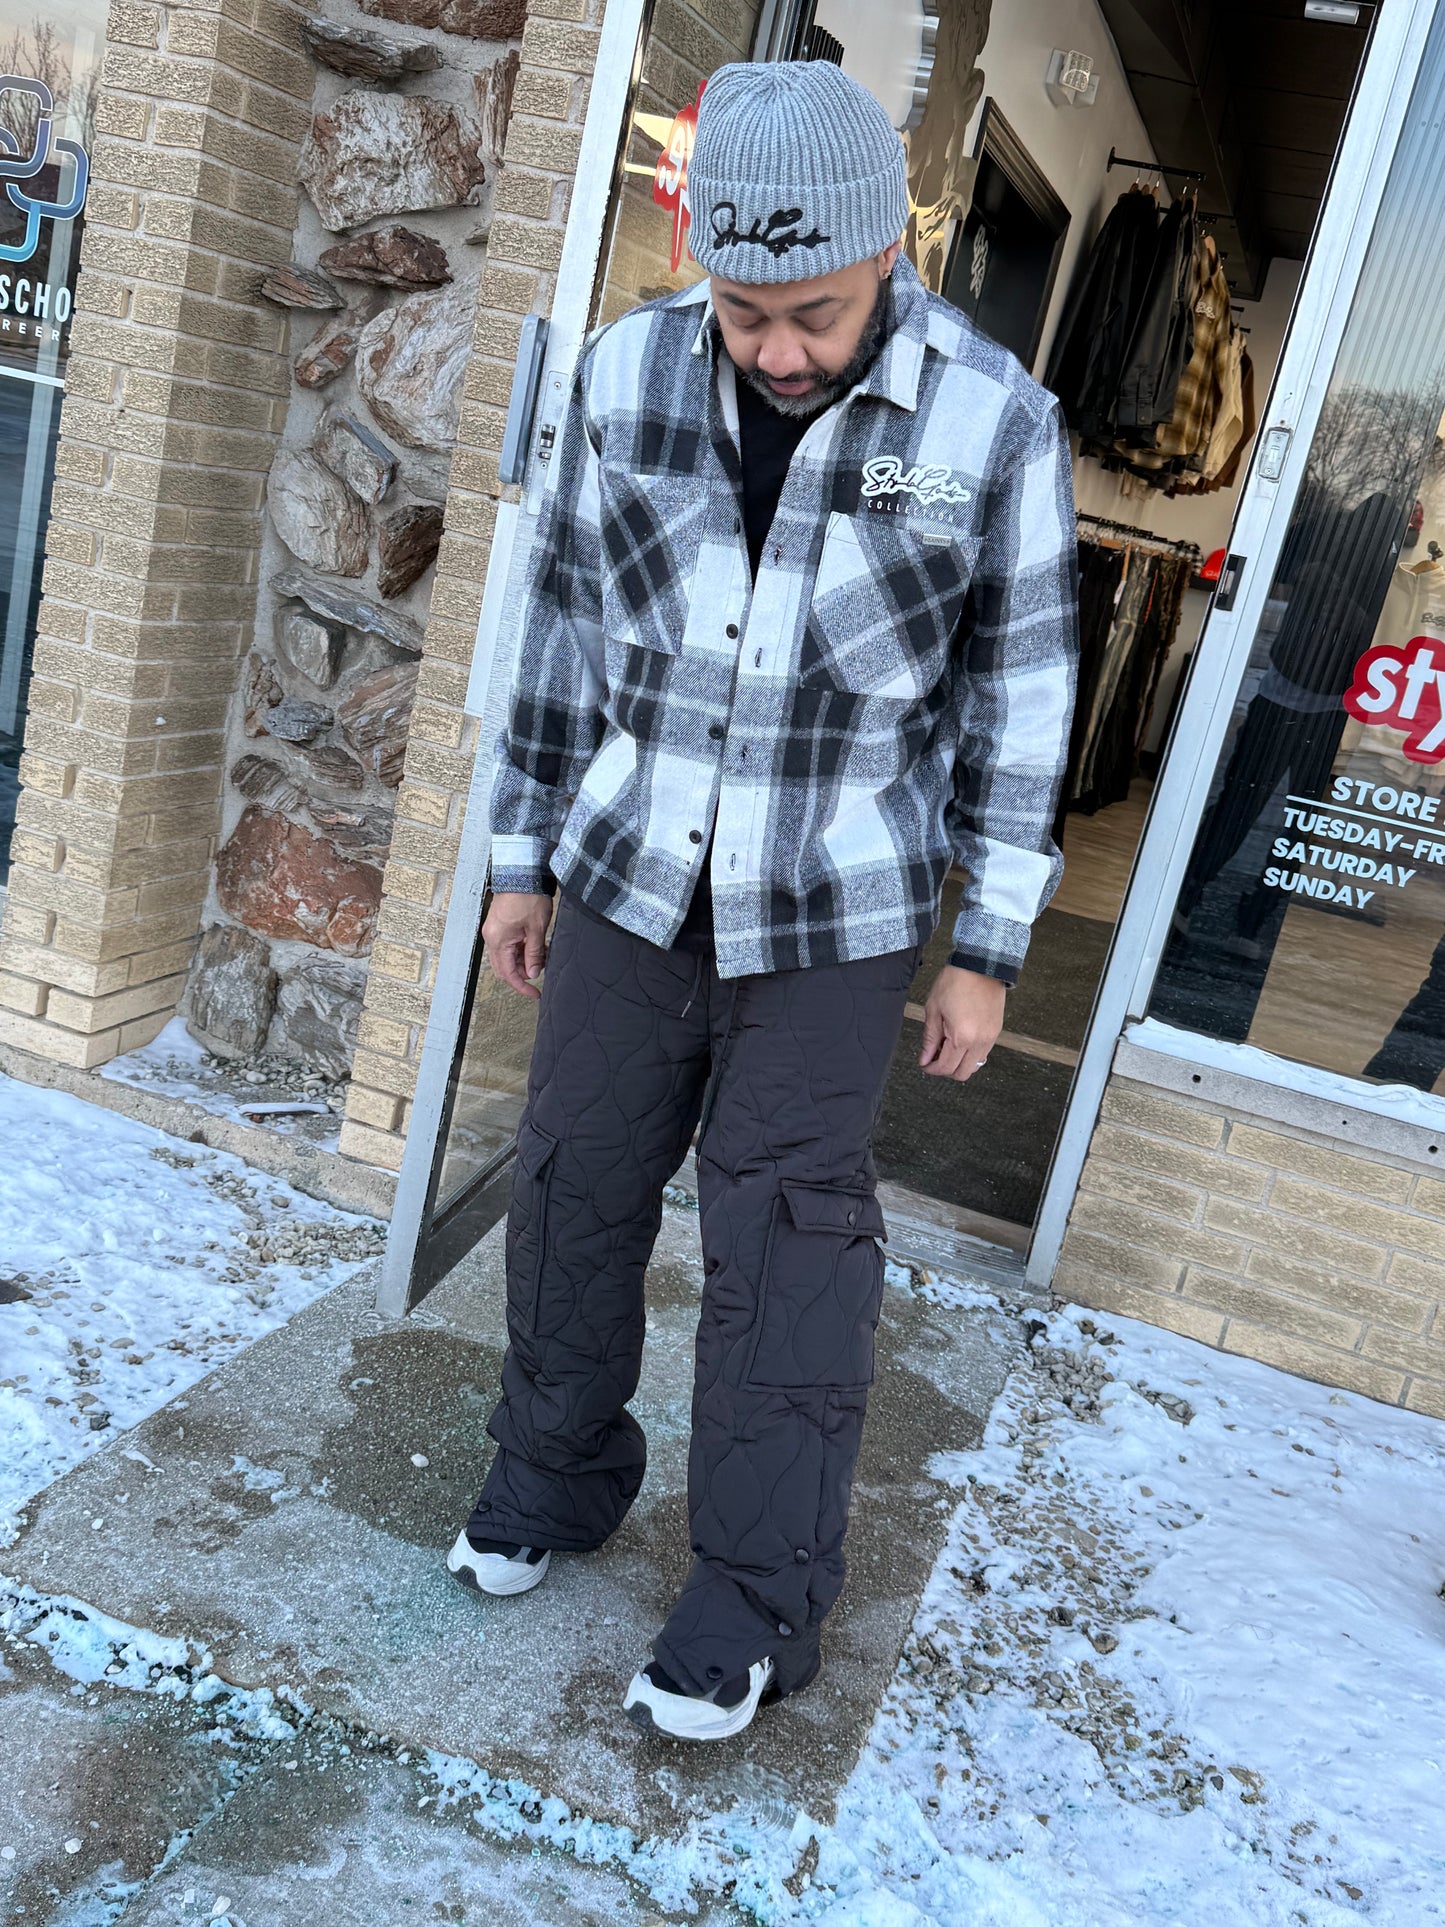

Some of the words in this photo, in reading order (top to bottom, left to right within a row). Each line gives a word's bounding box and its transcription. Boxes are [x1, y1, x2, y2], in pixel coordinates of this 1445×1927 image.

[867, 499, 955, 523] COLLECTION
[1331, 776, 1441, 823] STORE
[1271, 838, 1416, 888] SATURDAY
[1263, 867, 1375, 910] SUNDAY
